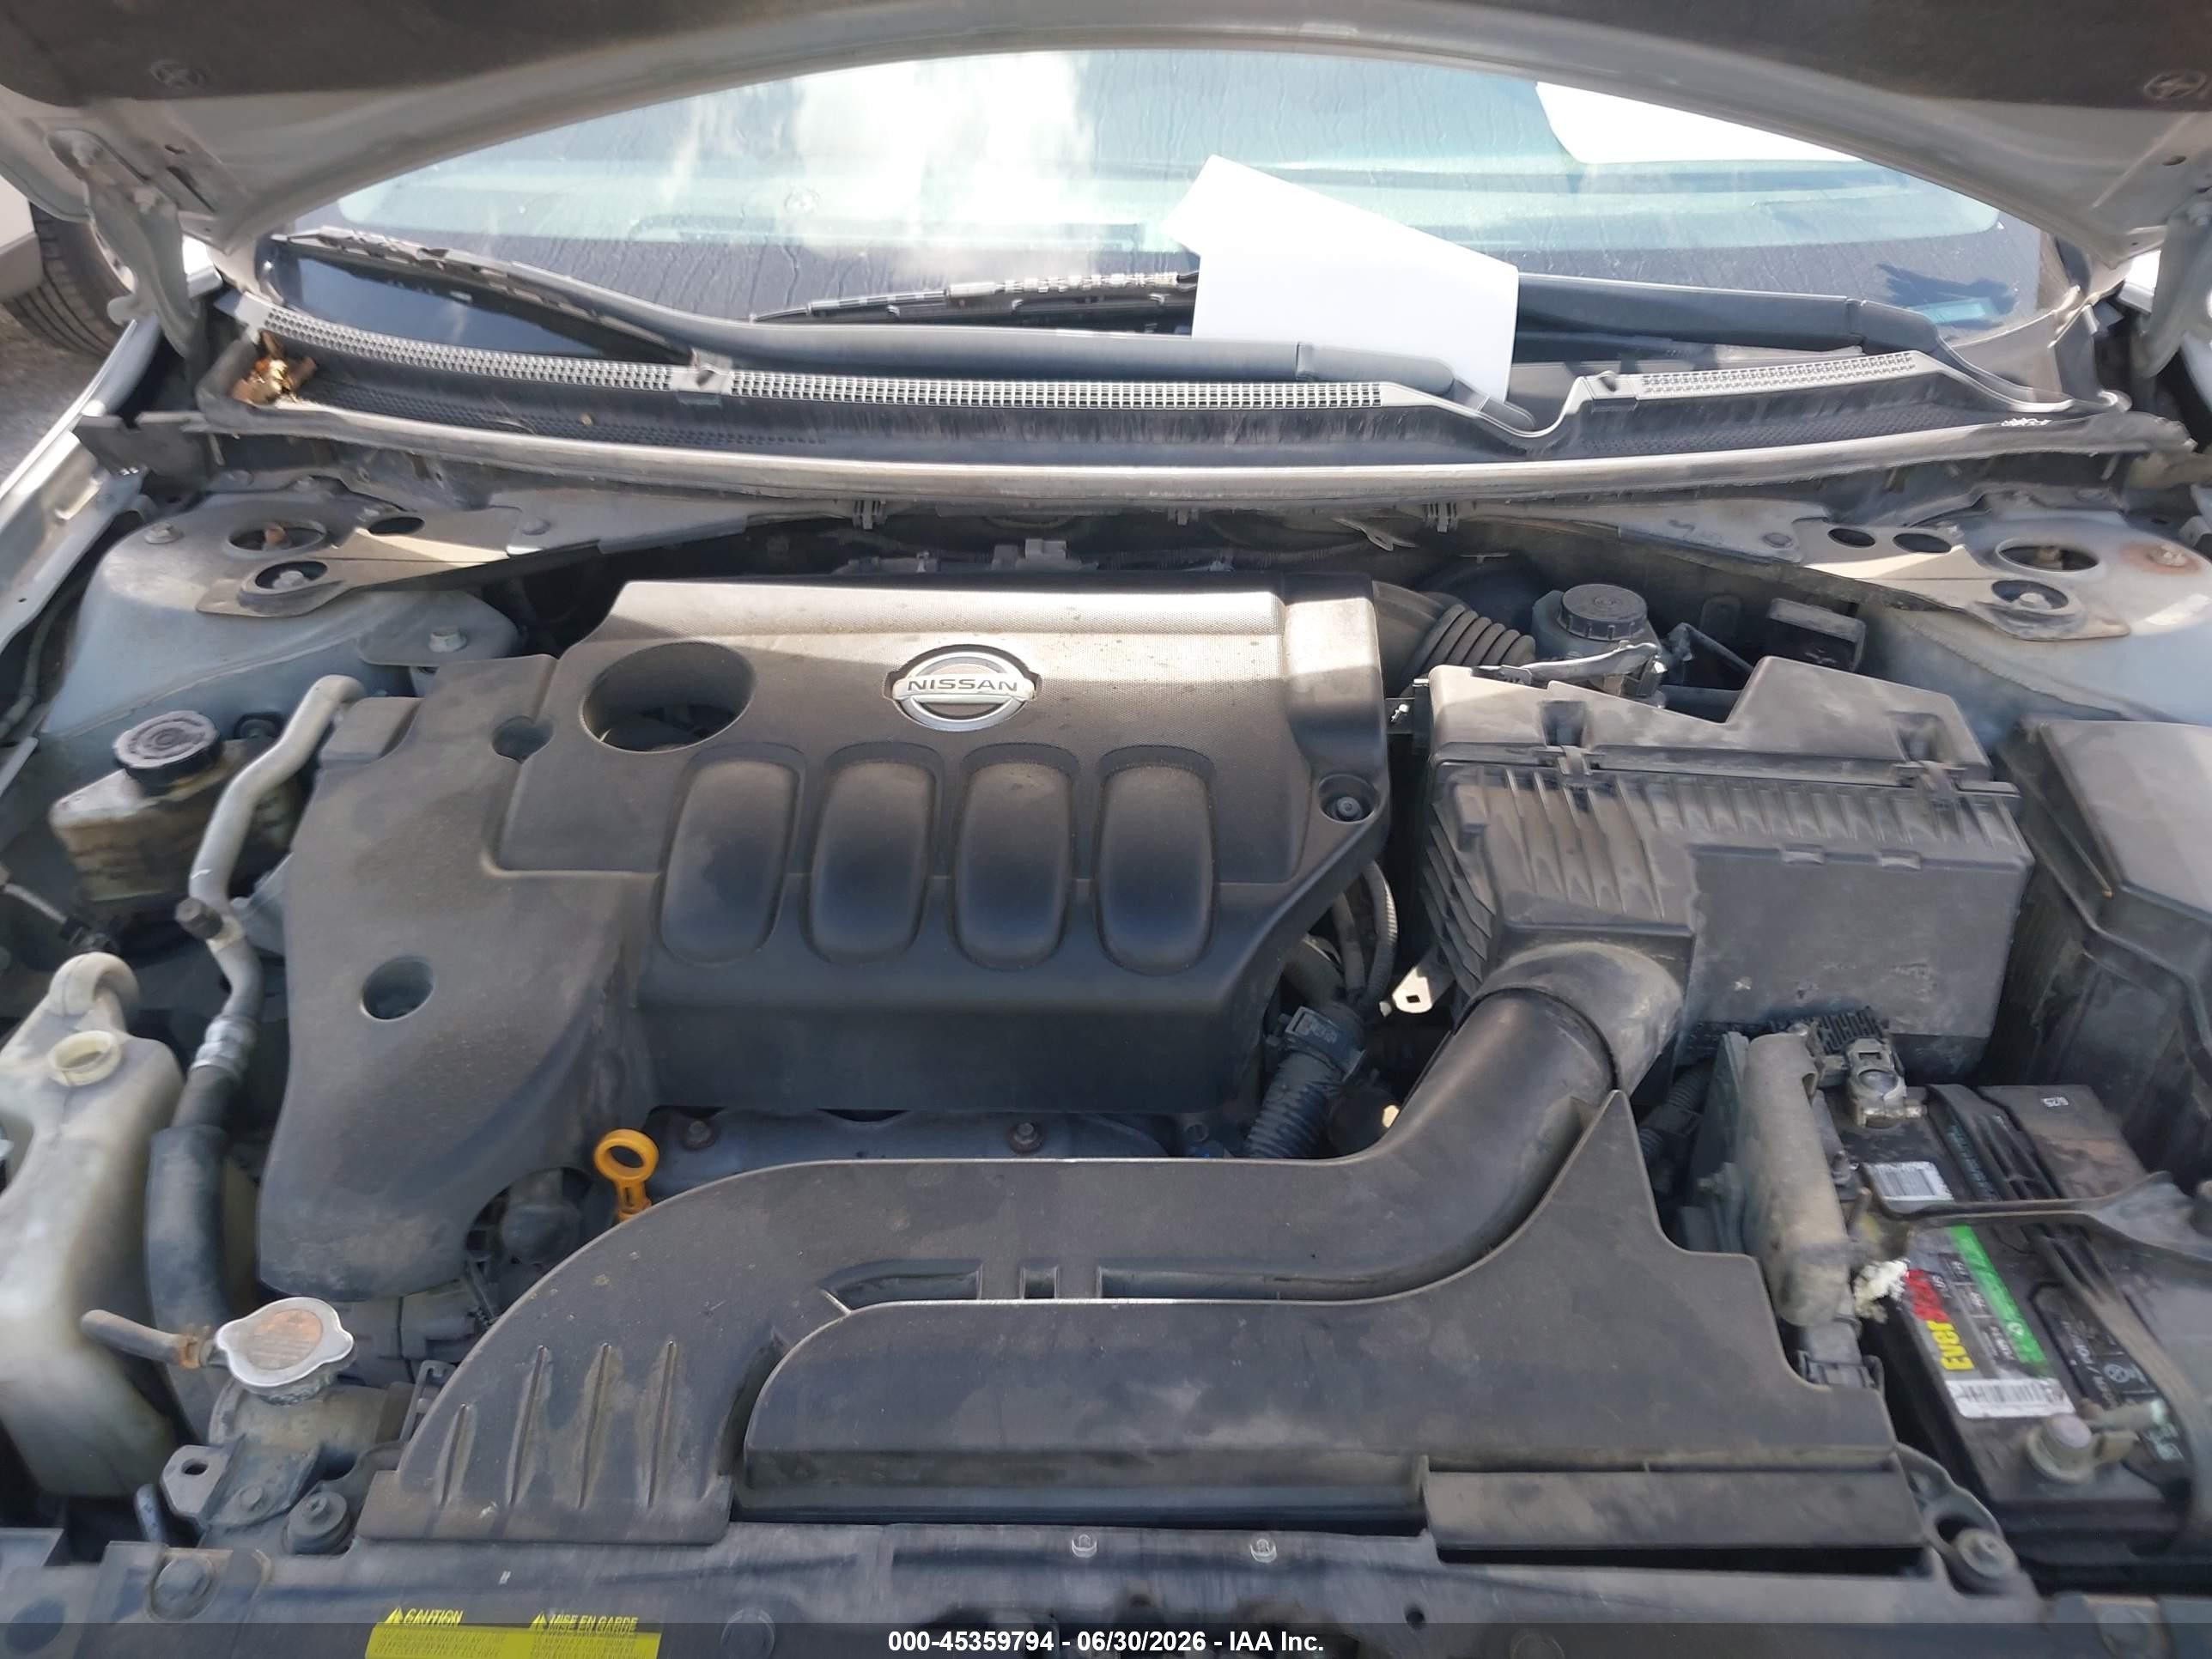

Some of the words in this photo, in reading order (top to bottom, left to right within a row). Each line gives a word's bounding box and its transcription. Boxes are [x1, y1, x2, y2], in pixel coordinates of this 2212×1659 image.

[908, 678, 1018, 692] NISSAN
[404, 1608, 464, 1626] CAUTION
[548, 1614, 579, 1631] MISE
[578, 1615, 597, 1632] EN
[595, 1617, 639, 1634] GARDE
